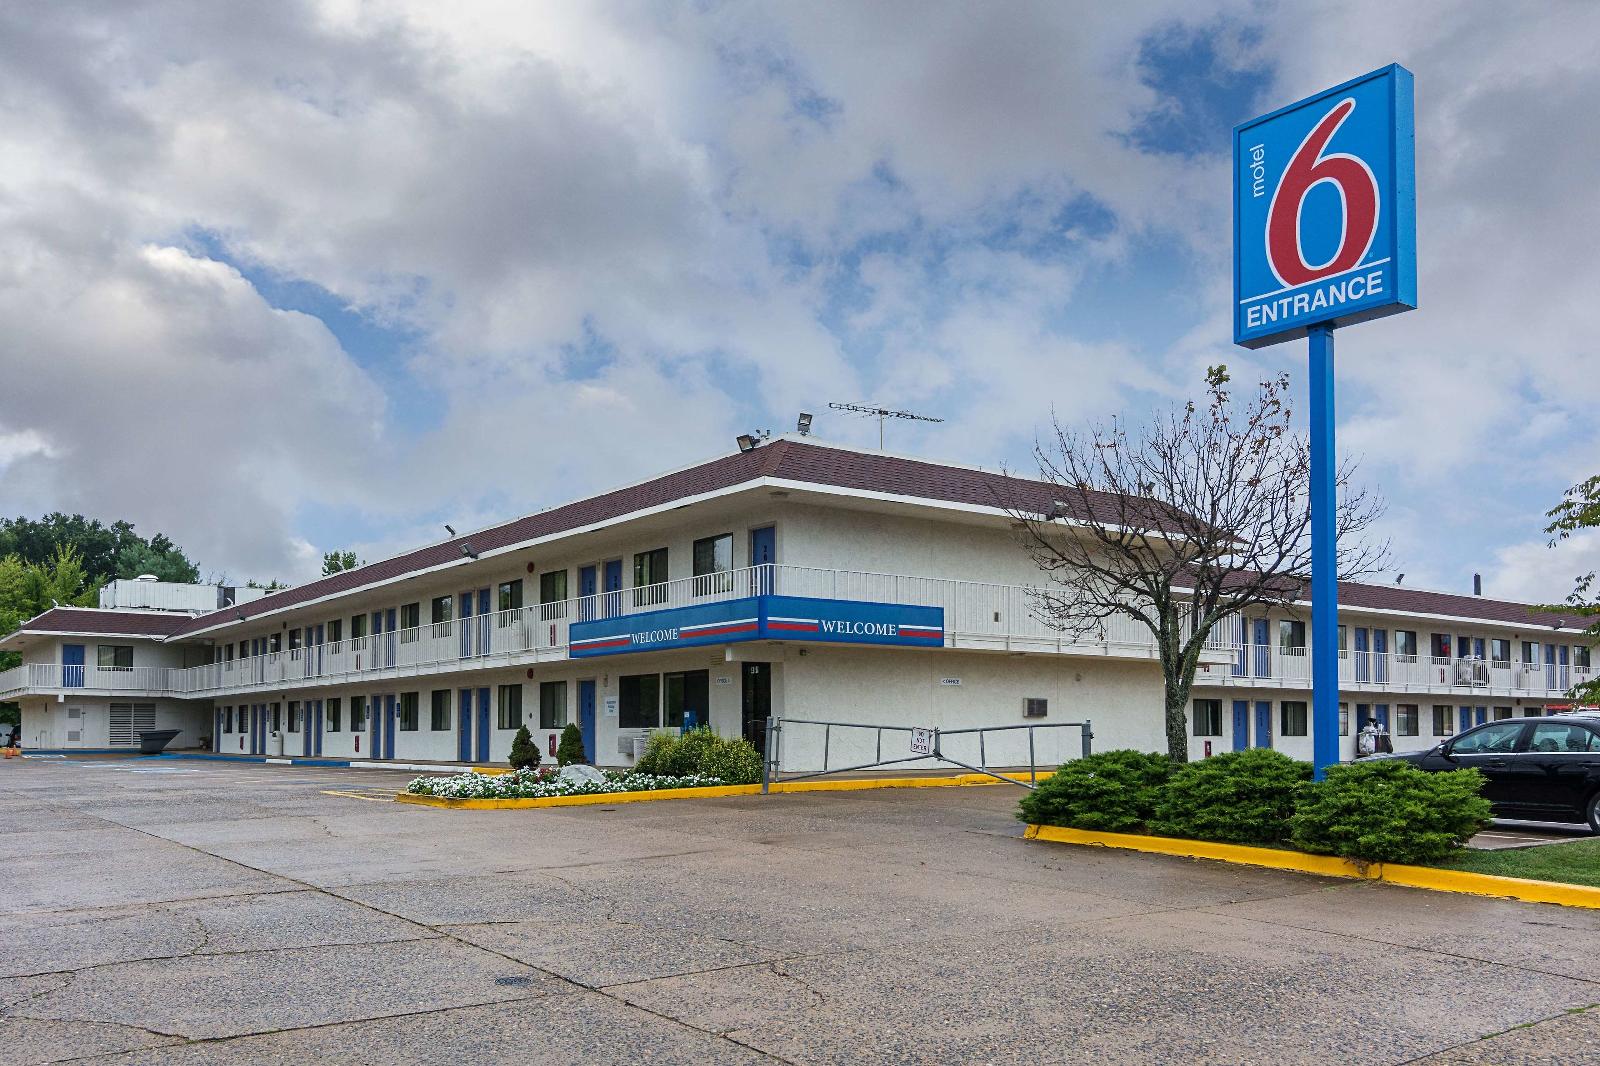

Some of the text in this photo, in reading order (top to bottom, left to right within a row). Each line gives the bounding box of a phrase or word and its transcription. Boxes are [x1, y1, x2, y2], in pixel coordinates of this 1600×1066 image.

[1250, 143, 1265, 198] motel
[1265, 97, 1381, 288] 6
[1247, 270, 1383, 328] ENTRANCE
[631, 628, 679, 644] WELCOME
[820, 619, 897, 636] WELCOME
